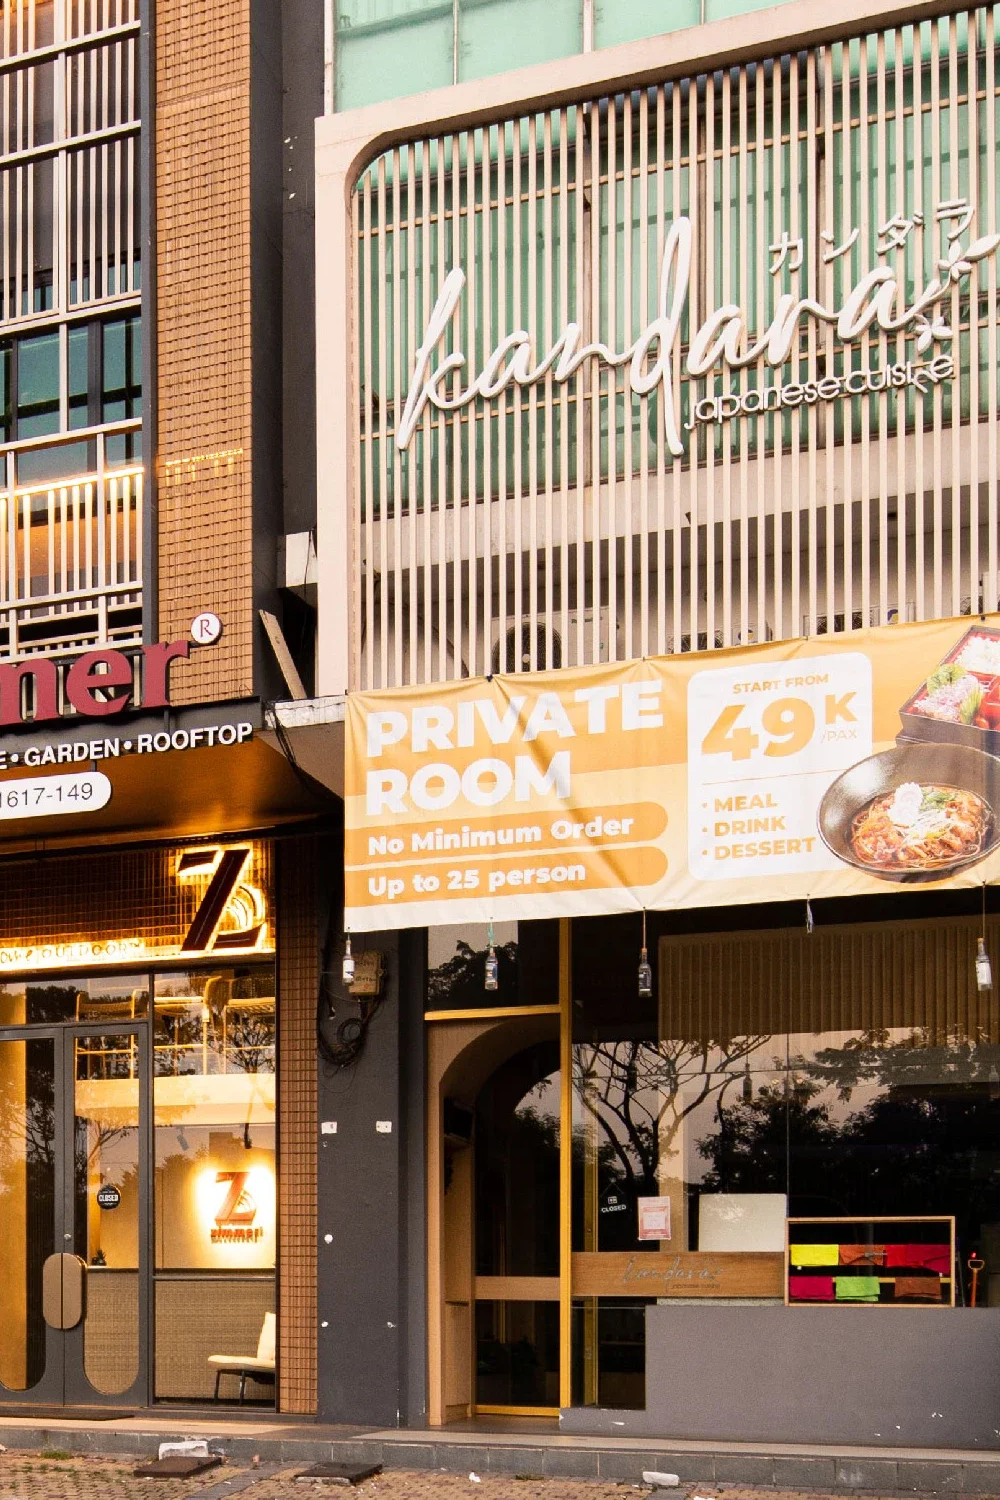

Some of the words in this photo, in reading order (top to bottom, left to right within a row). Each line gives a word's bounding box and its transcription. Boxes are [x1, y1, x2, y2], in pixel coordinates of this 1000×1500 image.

[769, 198, 975, 275] カンダラ
[396, 216, 943, 457] kandara
[684, 375, 842, 430] japanese
[845, 355, 954, 394] cuisine
[732, 680, 781, 695] START
[785, 674, 829, 688] FROM
[366, 680, 664, 758] PRIVATE
[820, 729, 858, 744] /PAX
[24, 737, 120, 767] GARDEN
[137, 722, 253, 754] ROOFTOP
[366, 750, 571, 816] ROOM
[714, 794, 778, 813] MEAL
[368, 834, 405, 856] No
[411, 824, 542, 852] Minimum
[551, 815, 634, 841] Order
[714, 816, 786, 837] DRINK
[714, 836, 817, 861] DESSERT
[368, 875, 405, 900] Up
[412, 872, 440, 893] to
[447, 868, 480, 891] 25
[488, 863, 586, 893] person
[601, 1204, 627, 1214] CLOSED
